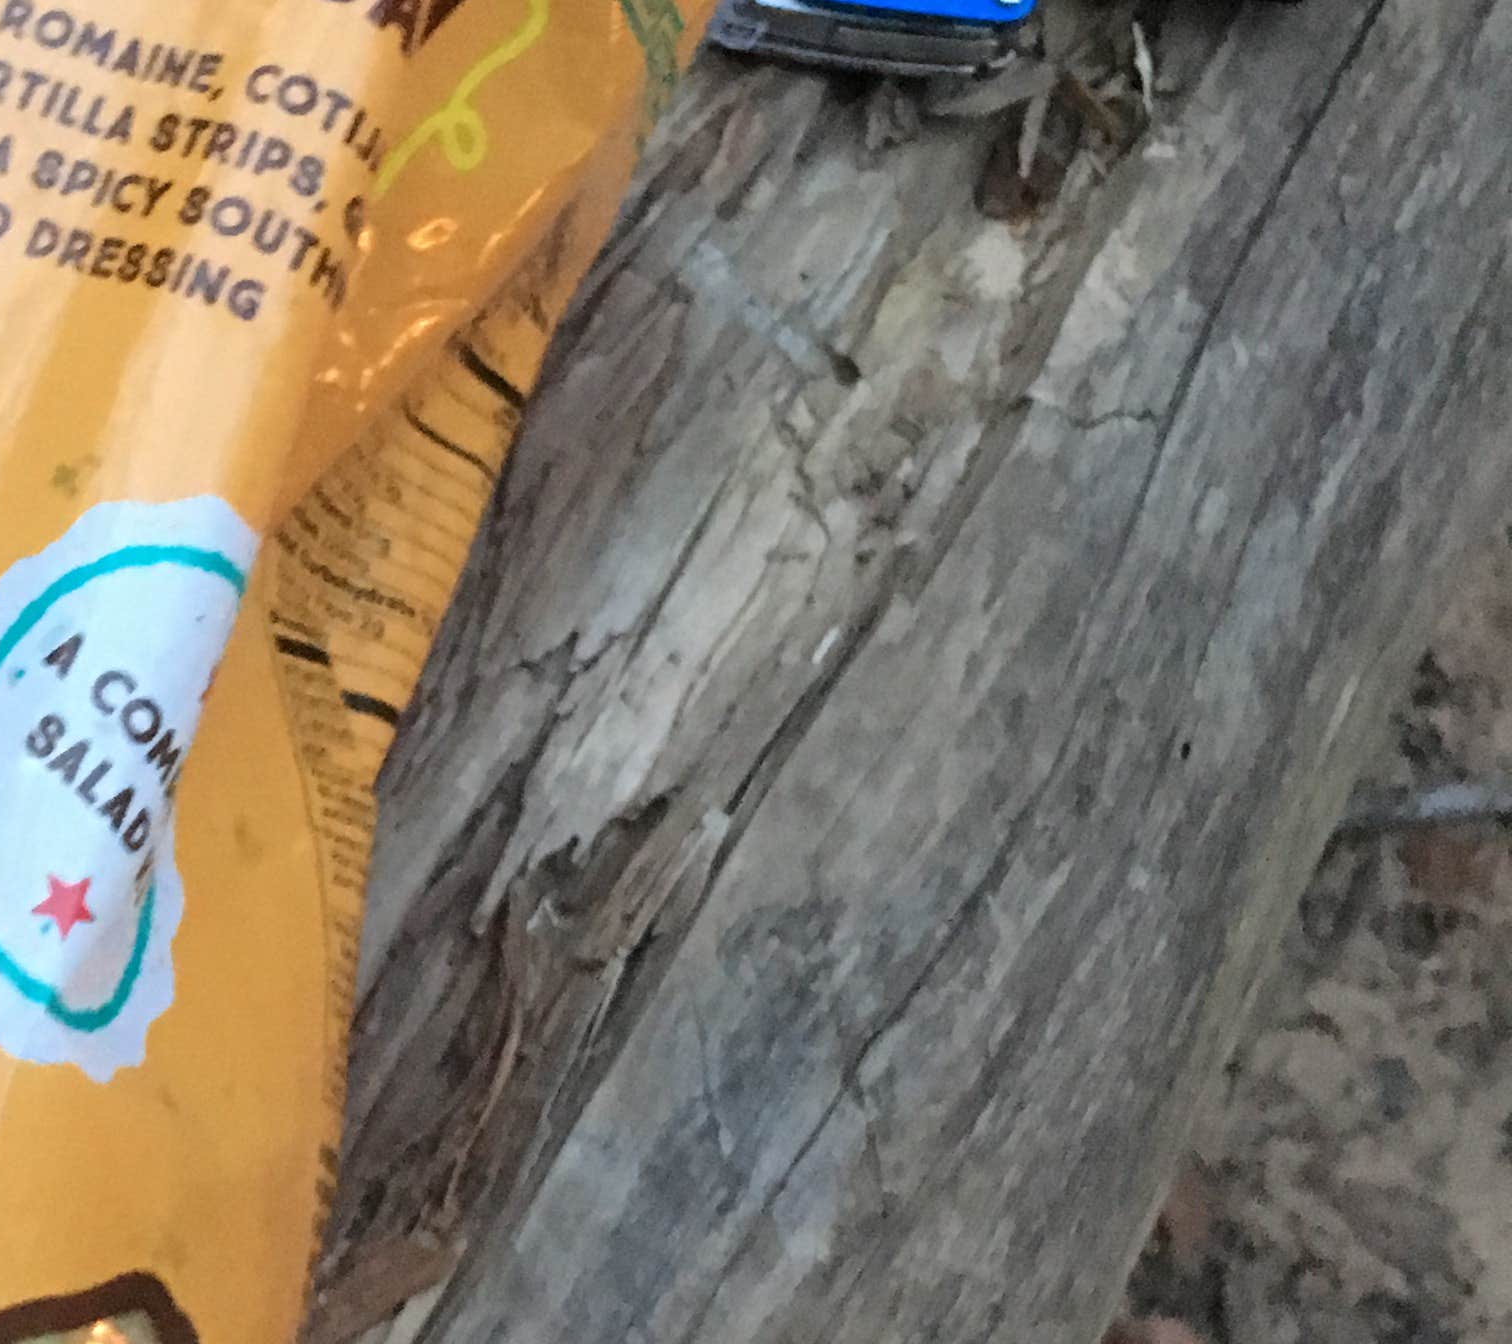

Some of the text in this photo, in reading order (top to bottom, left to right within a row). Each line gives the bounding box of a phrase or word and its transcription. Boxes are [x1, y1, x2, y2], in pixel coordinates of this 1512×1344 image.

[30, 150, 173, 218] SPICY
[149, 113, 329, 213] STRIPS,
[25, 220, 268, 322] DRESSING
[43, 632, 86, 680] A
[26, 712, 151, 855] SALAD
